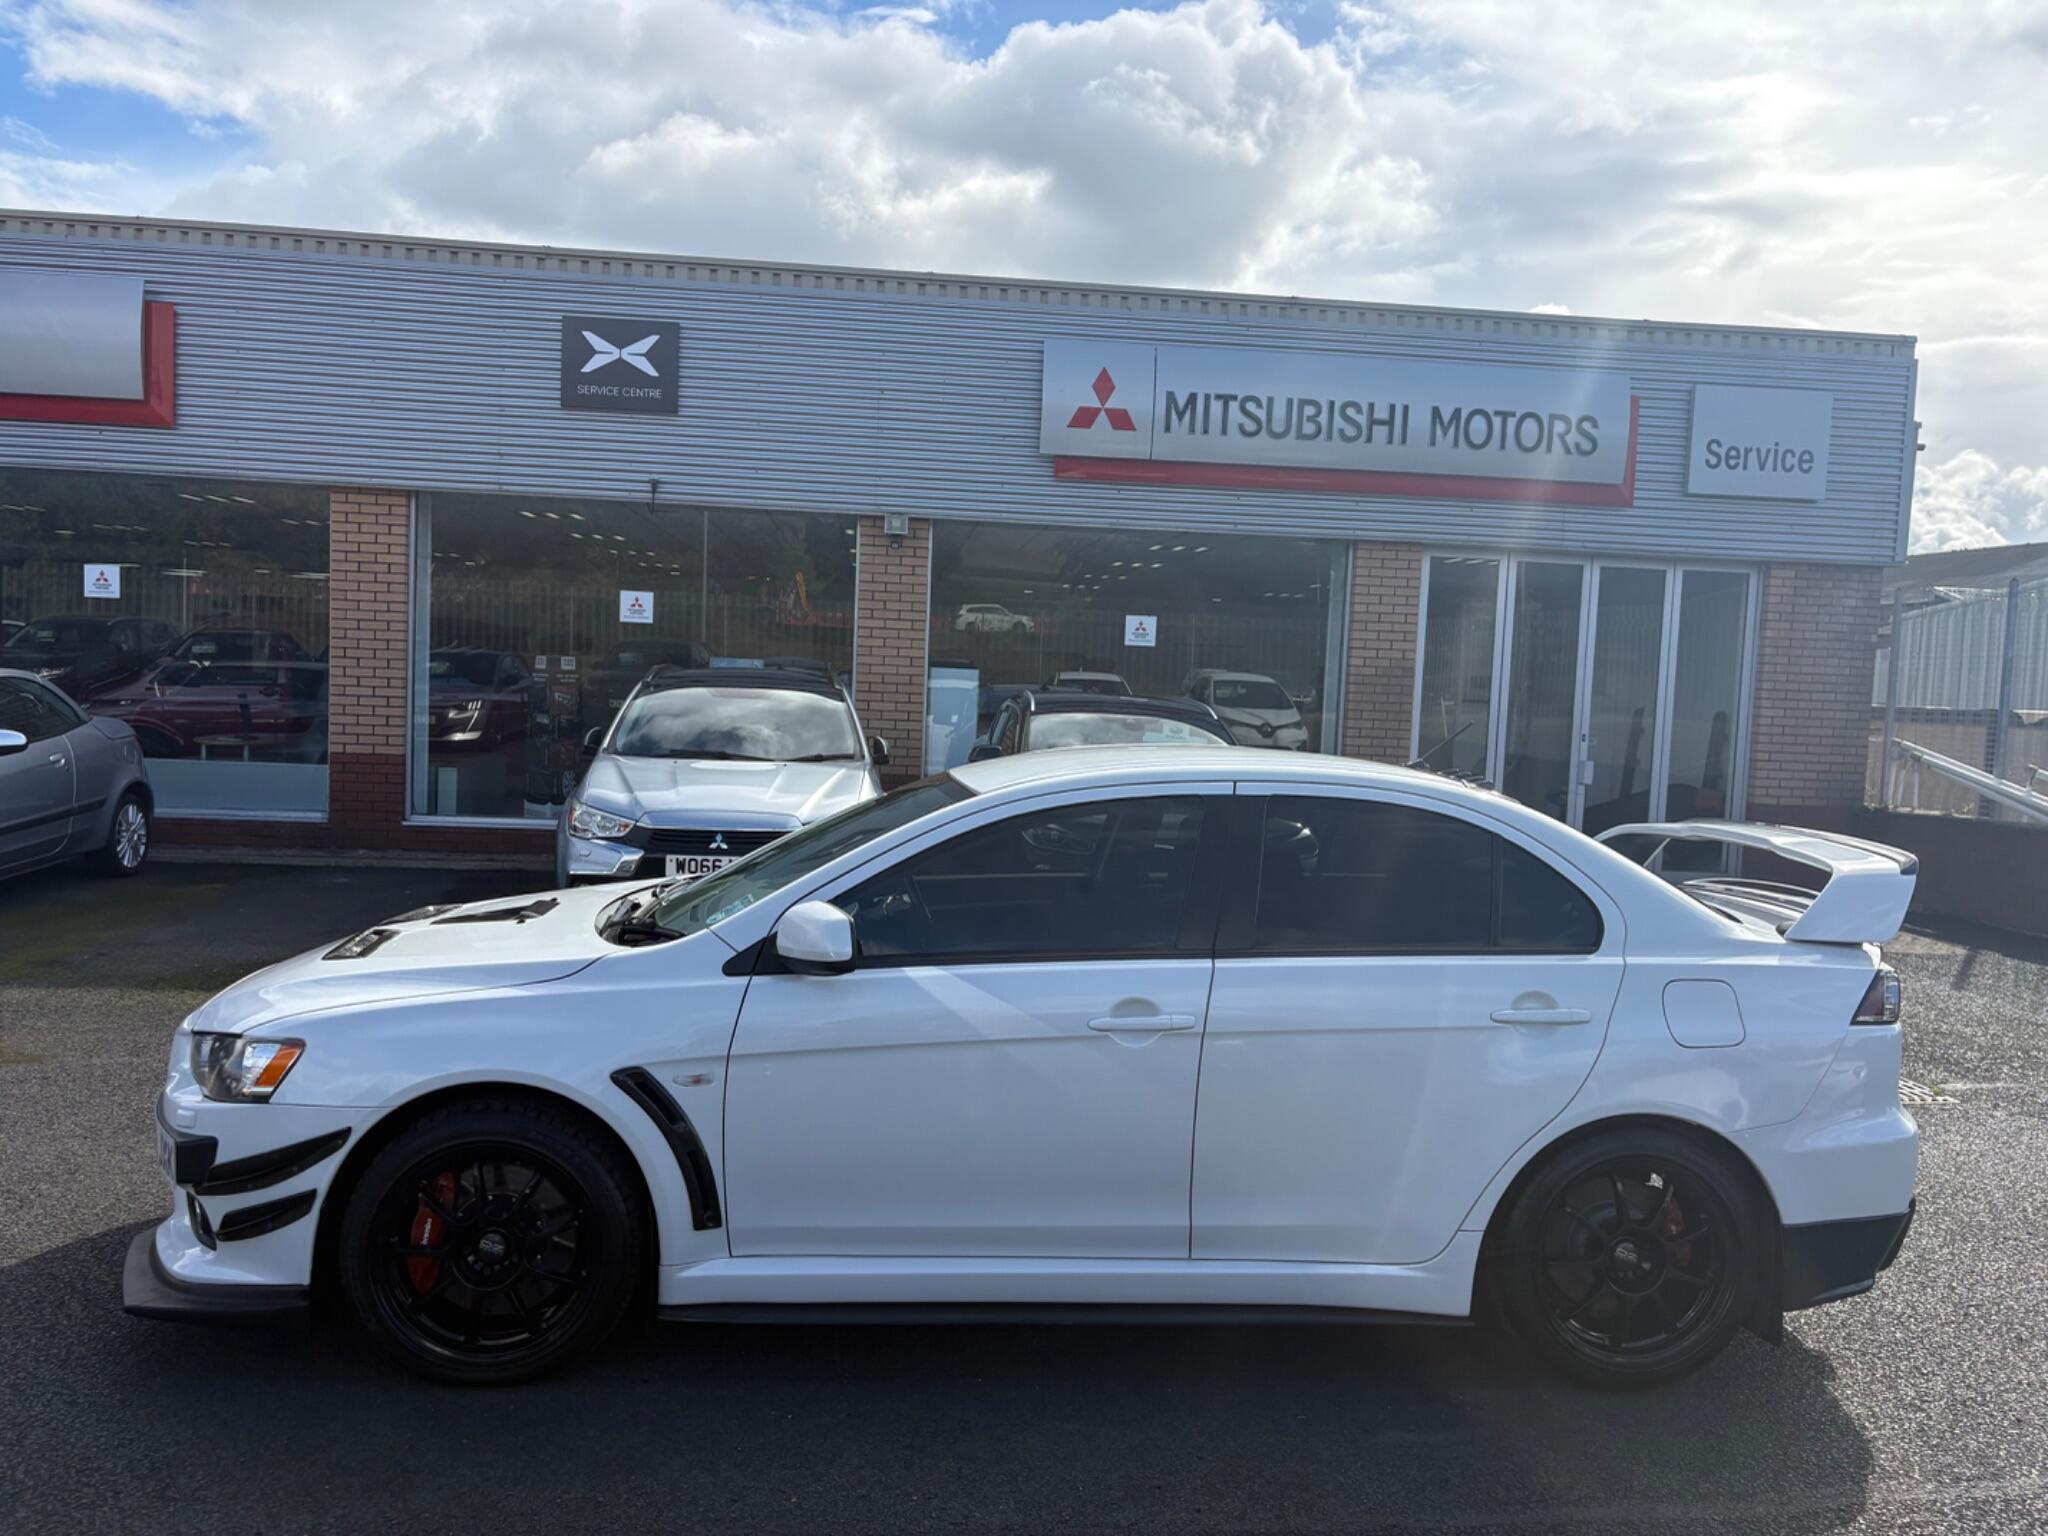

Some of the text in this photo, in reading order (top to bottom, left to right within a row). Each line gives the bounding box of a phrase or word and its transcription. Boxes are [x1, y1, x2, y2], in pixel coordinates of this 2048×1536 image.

[577, 384, 662, 399] SERVICE CENTRE
[1163, 389, 1600, 457] MITSUBISHI MOTORS
[1704, 438, 1815, 474] Service
